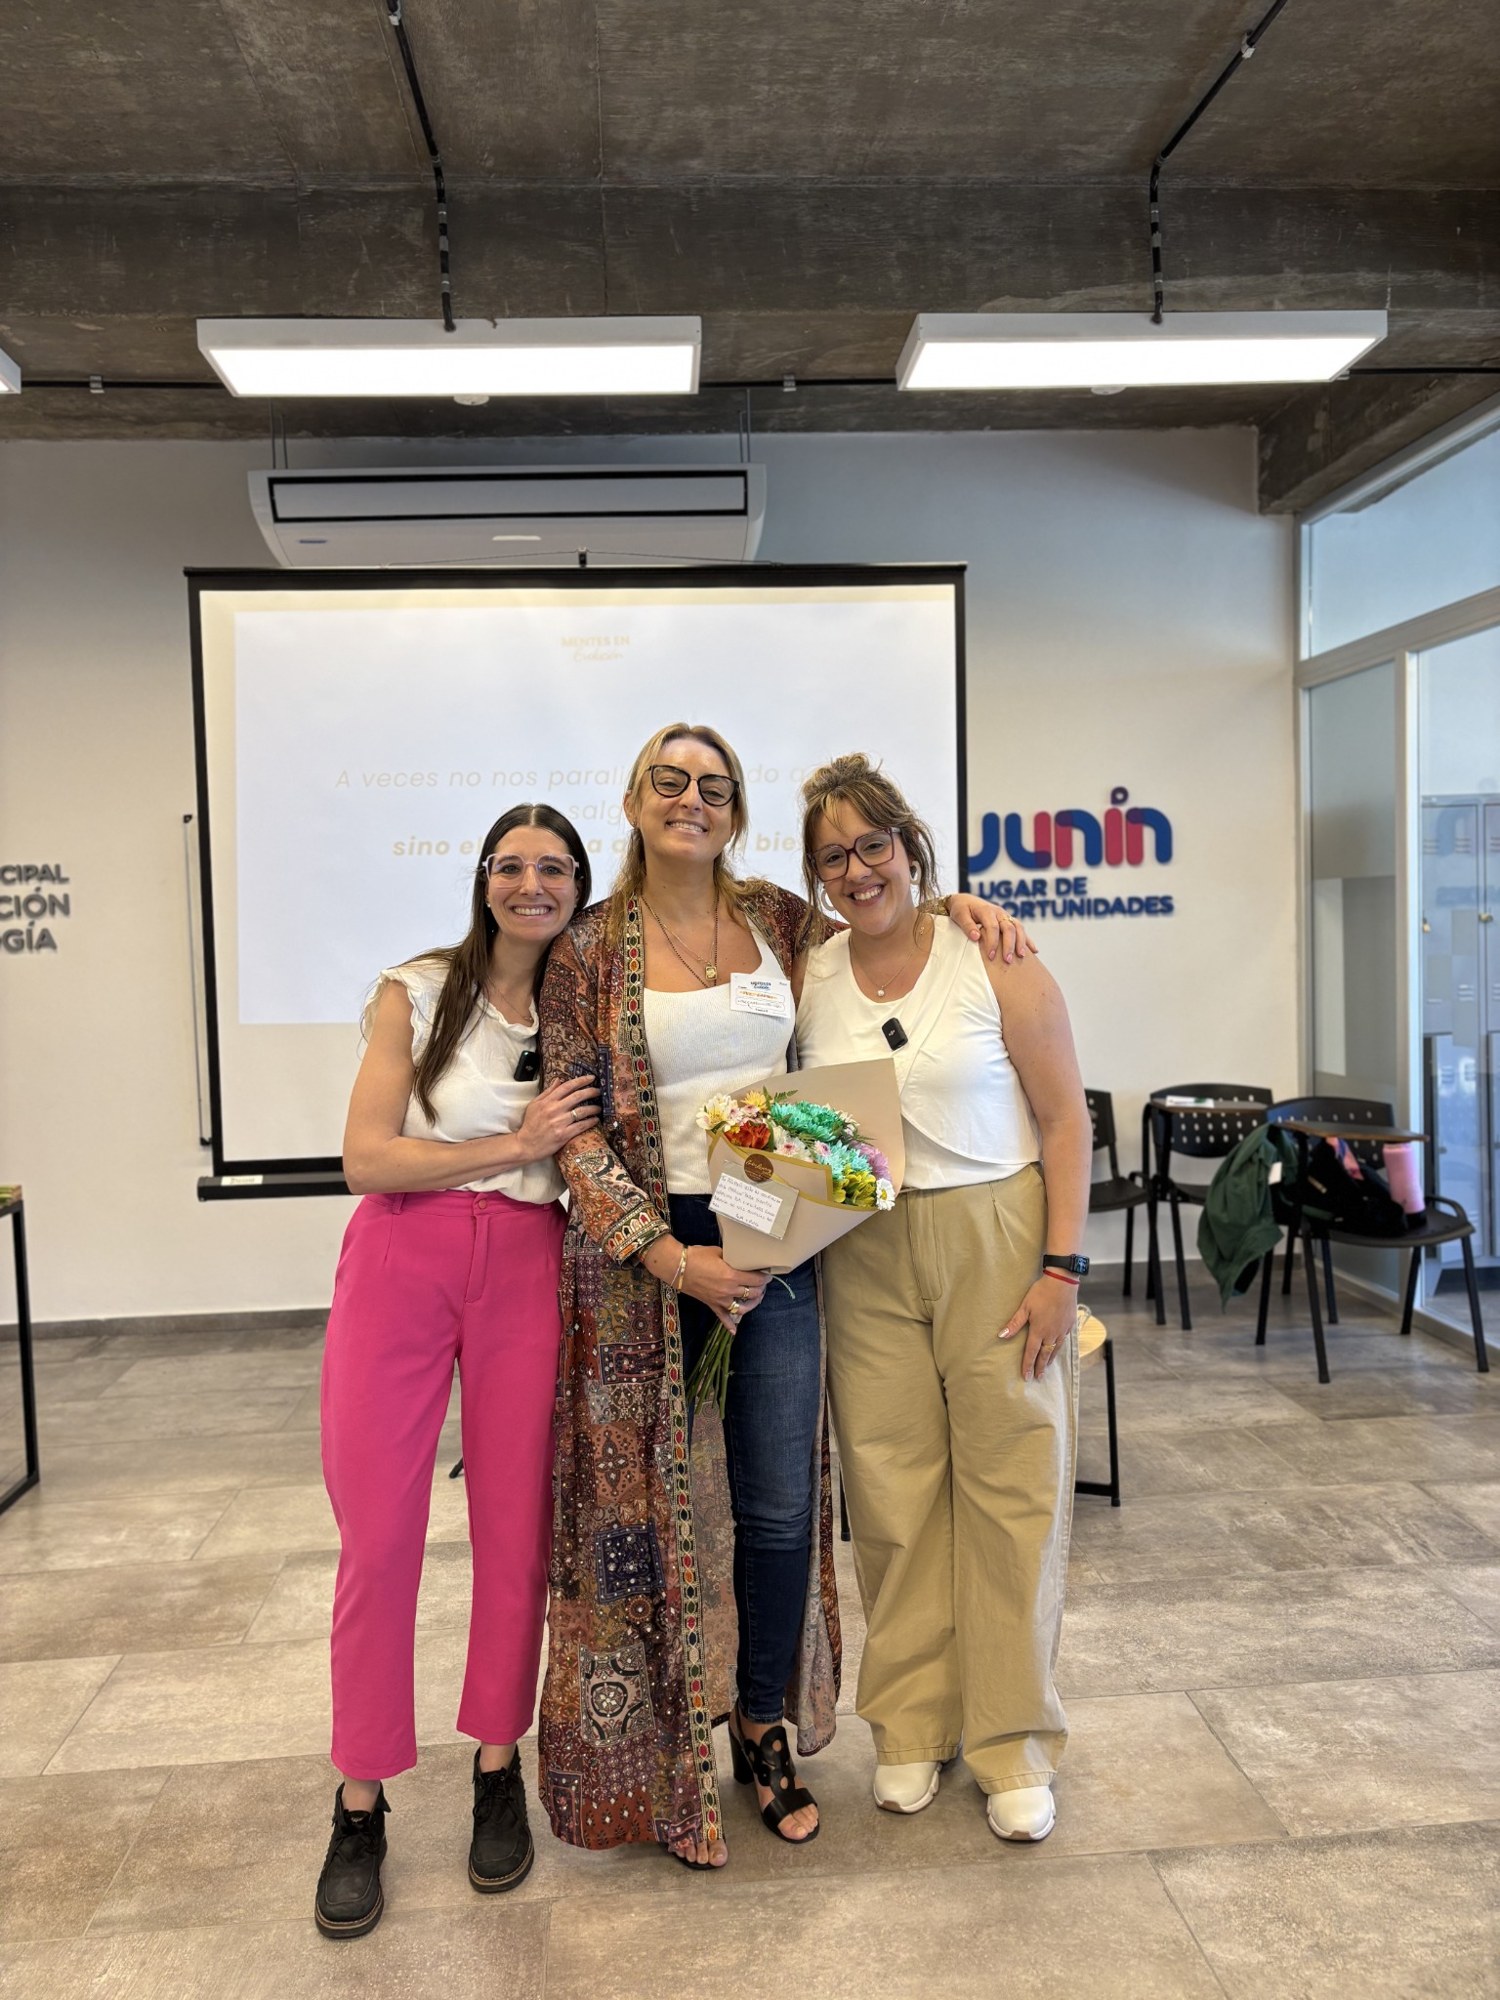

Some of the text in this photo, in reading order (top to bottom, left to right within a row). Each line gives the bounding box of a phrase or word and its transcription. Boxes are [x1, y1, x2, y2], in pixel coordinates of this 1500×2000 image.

[335, 769, 350, 788] A
[362, 772, 438, 788] veces
[448, 771, 482, 787] no
[492, 770, 538, 787] nos
[547, 765, 626, 792] parali
[747, 764, 779, 783] do
[568, 800, 622, 826] salg
[392, 835, 450, 856] sino
[756, 831, 796, 852] bie
[0, 863, 70, 885] CIPAL
[968, 876, 1088, 899] UGAR DE
[991, 896, 1175, 919] ORTUNIDADES
[0, 920, 58, 954] GÍA
